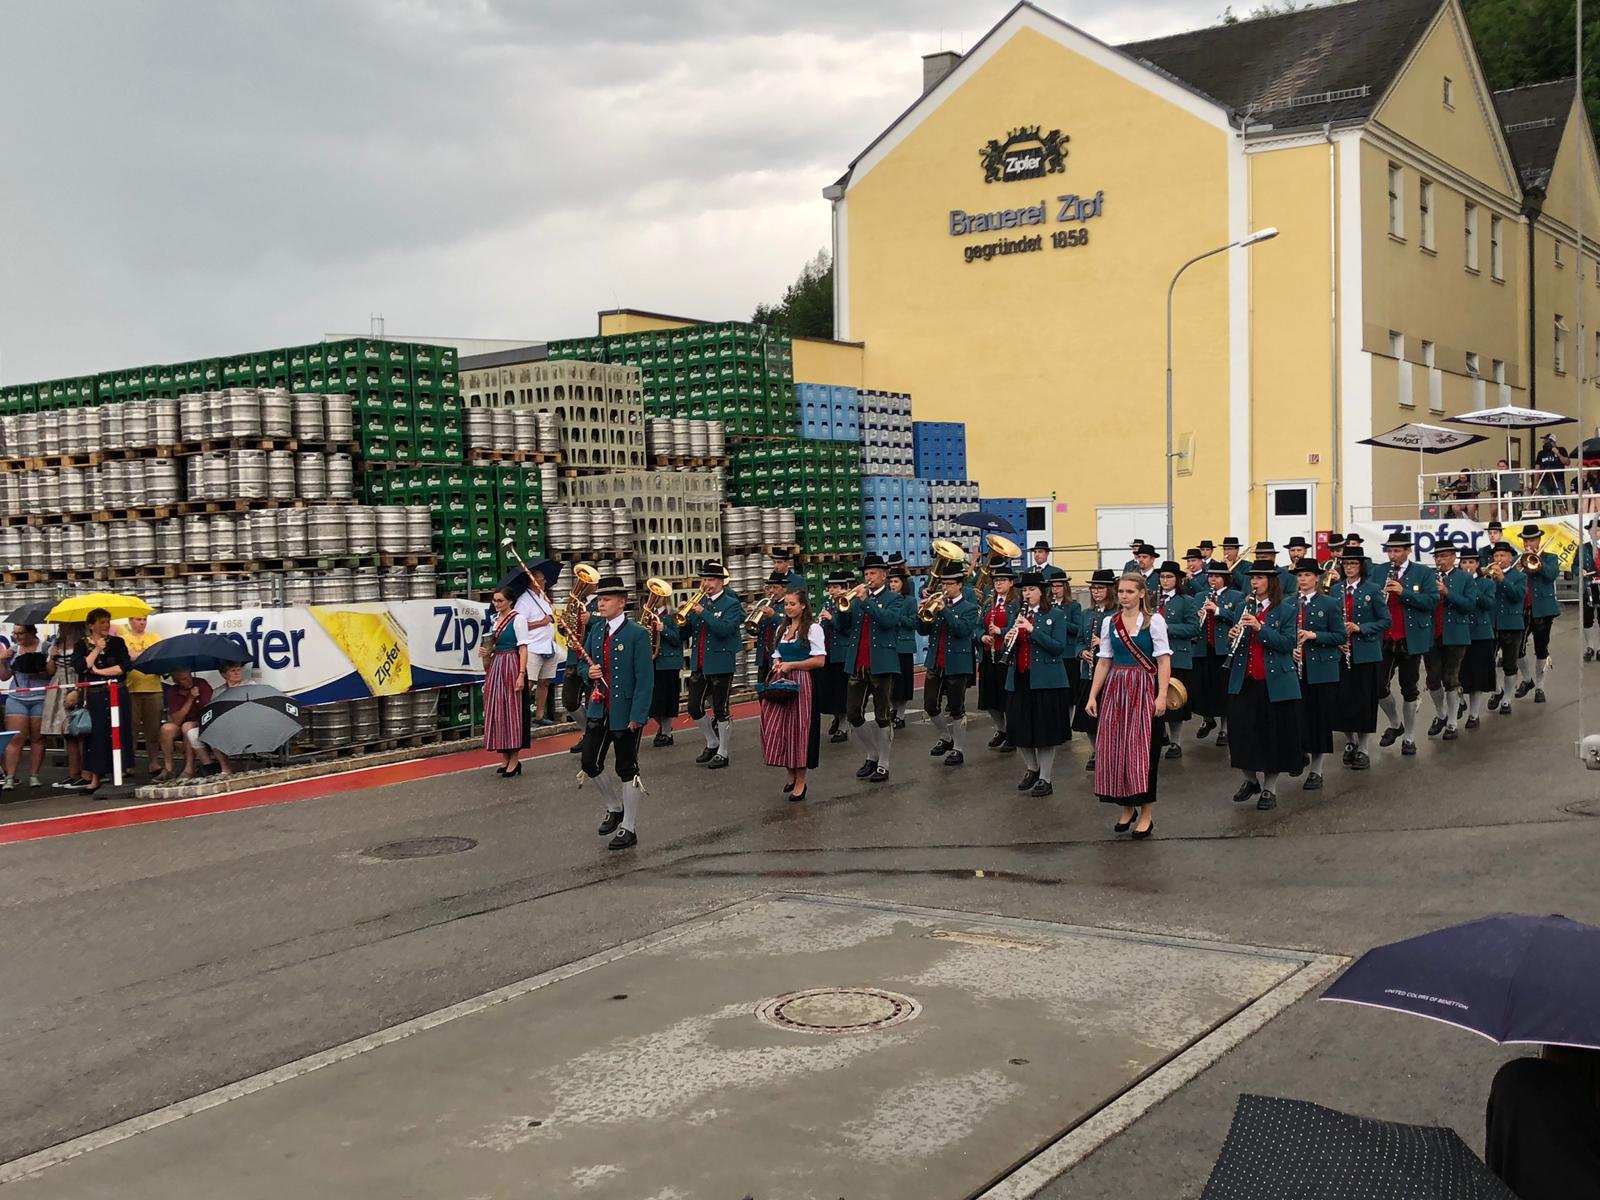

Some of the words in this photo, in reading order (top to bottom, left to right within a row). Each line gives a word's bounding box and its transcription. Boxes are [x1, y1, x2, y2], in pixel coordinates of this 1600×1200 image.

[1005, 155, 1042, 173] Zipfer
[949, 199, 1046, 236] Brauerei
[1057, 190, 1104, 223] Zipf
[964, 234, 1043, 264] gegründet
[1050, 228, 1089, 249] 1858
[222, 619, 242, 628] 1858
[185, 616, 305, 670] fer
[374, 642, 400, 686] Zipfer
[1437, 997, 1468, 1010] BENETTON
